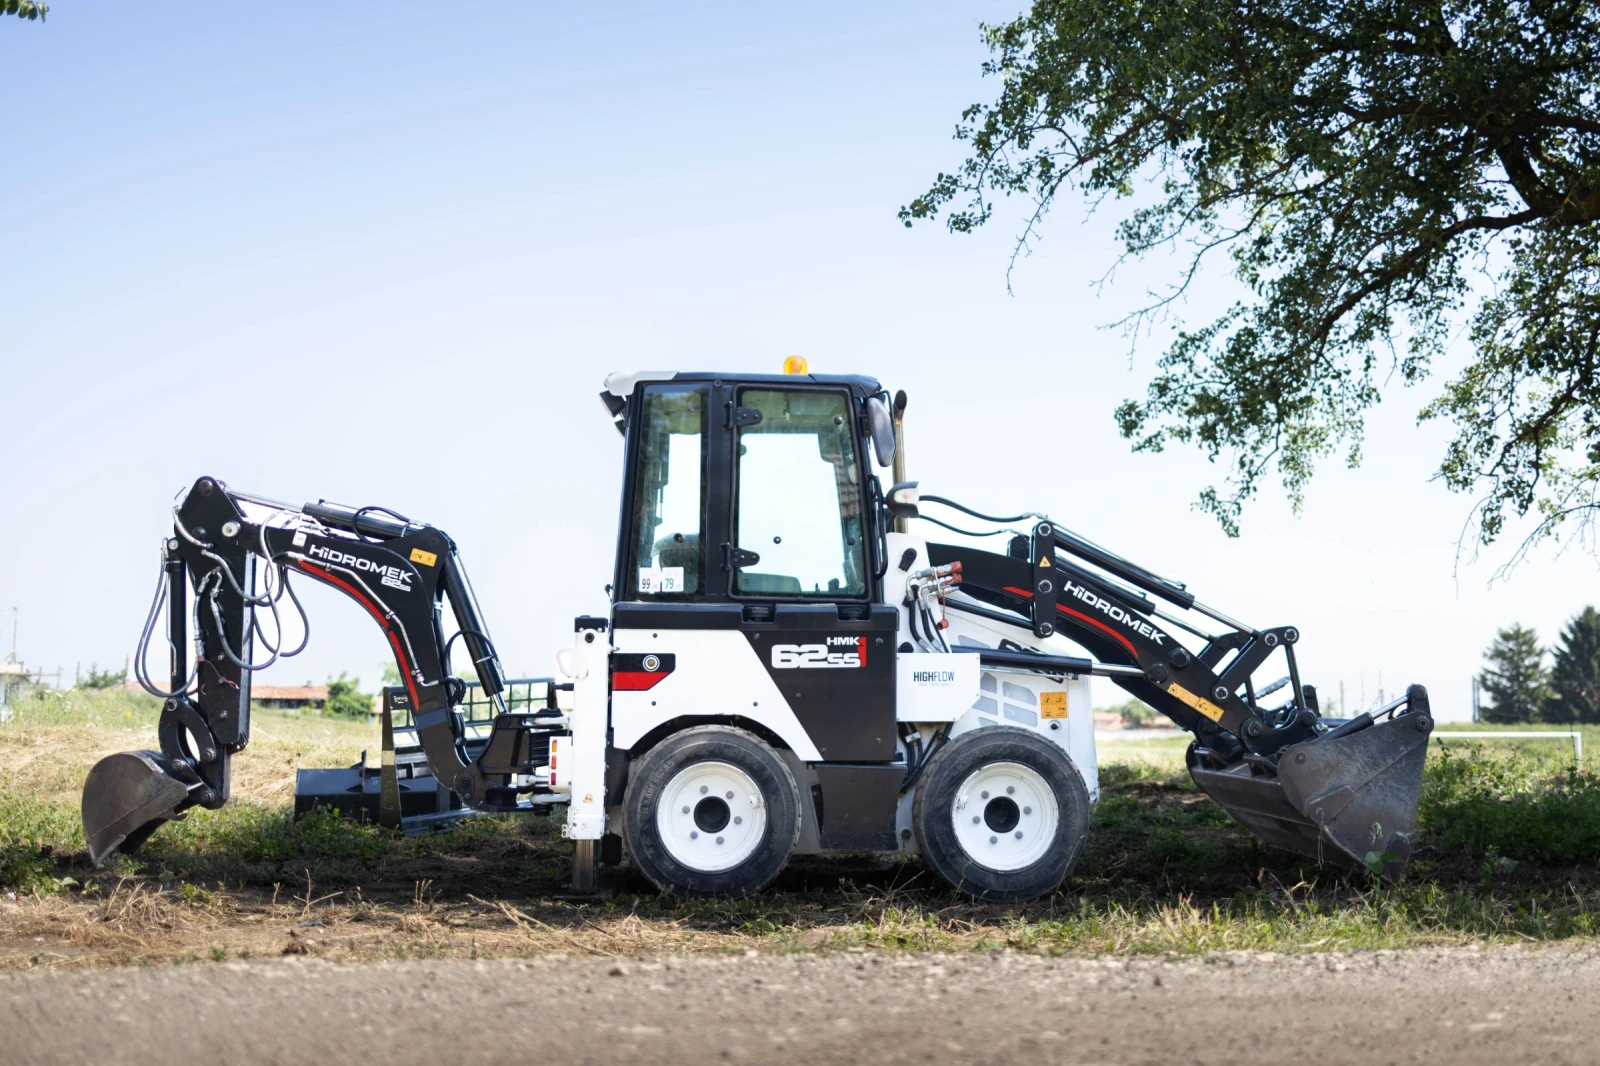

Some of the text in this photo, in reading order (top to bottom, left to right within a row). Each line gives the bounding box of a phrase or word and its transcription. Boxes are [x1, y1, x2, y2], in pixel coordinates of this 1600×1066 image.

[642, 578, 651, 589] 99
[665, 578, 674, 589] 79
[826, 636, 860, 646] HMK
[913, 671, 954, 682] HIGHFLOW
